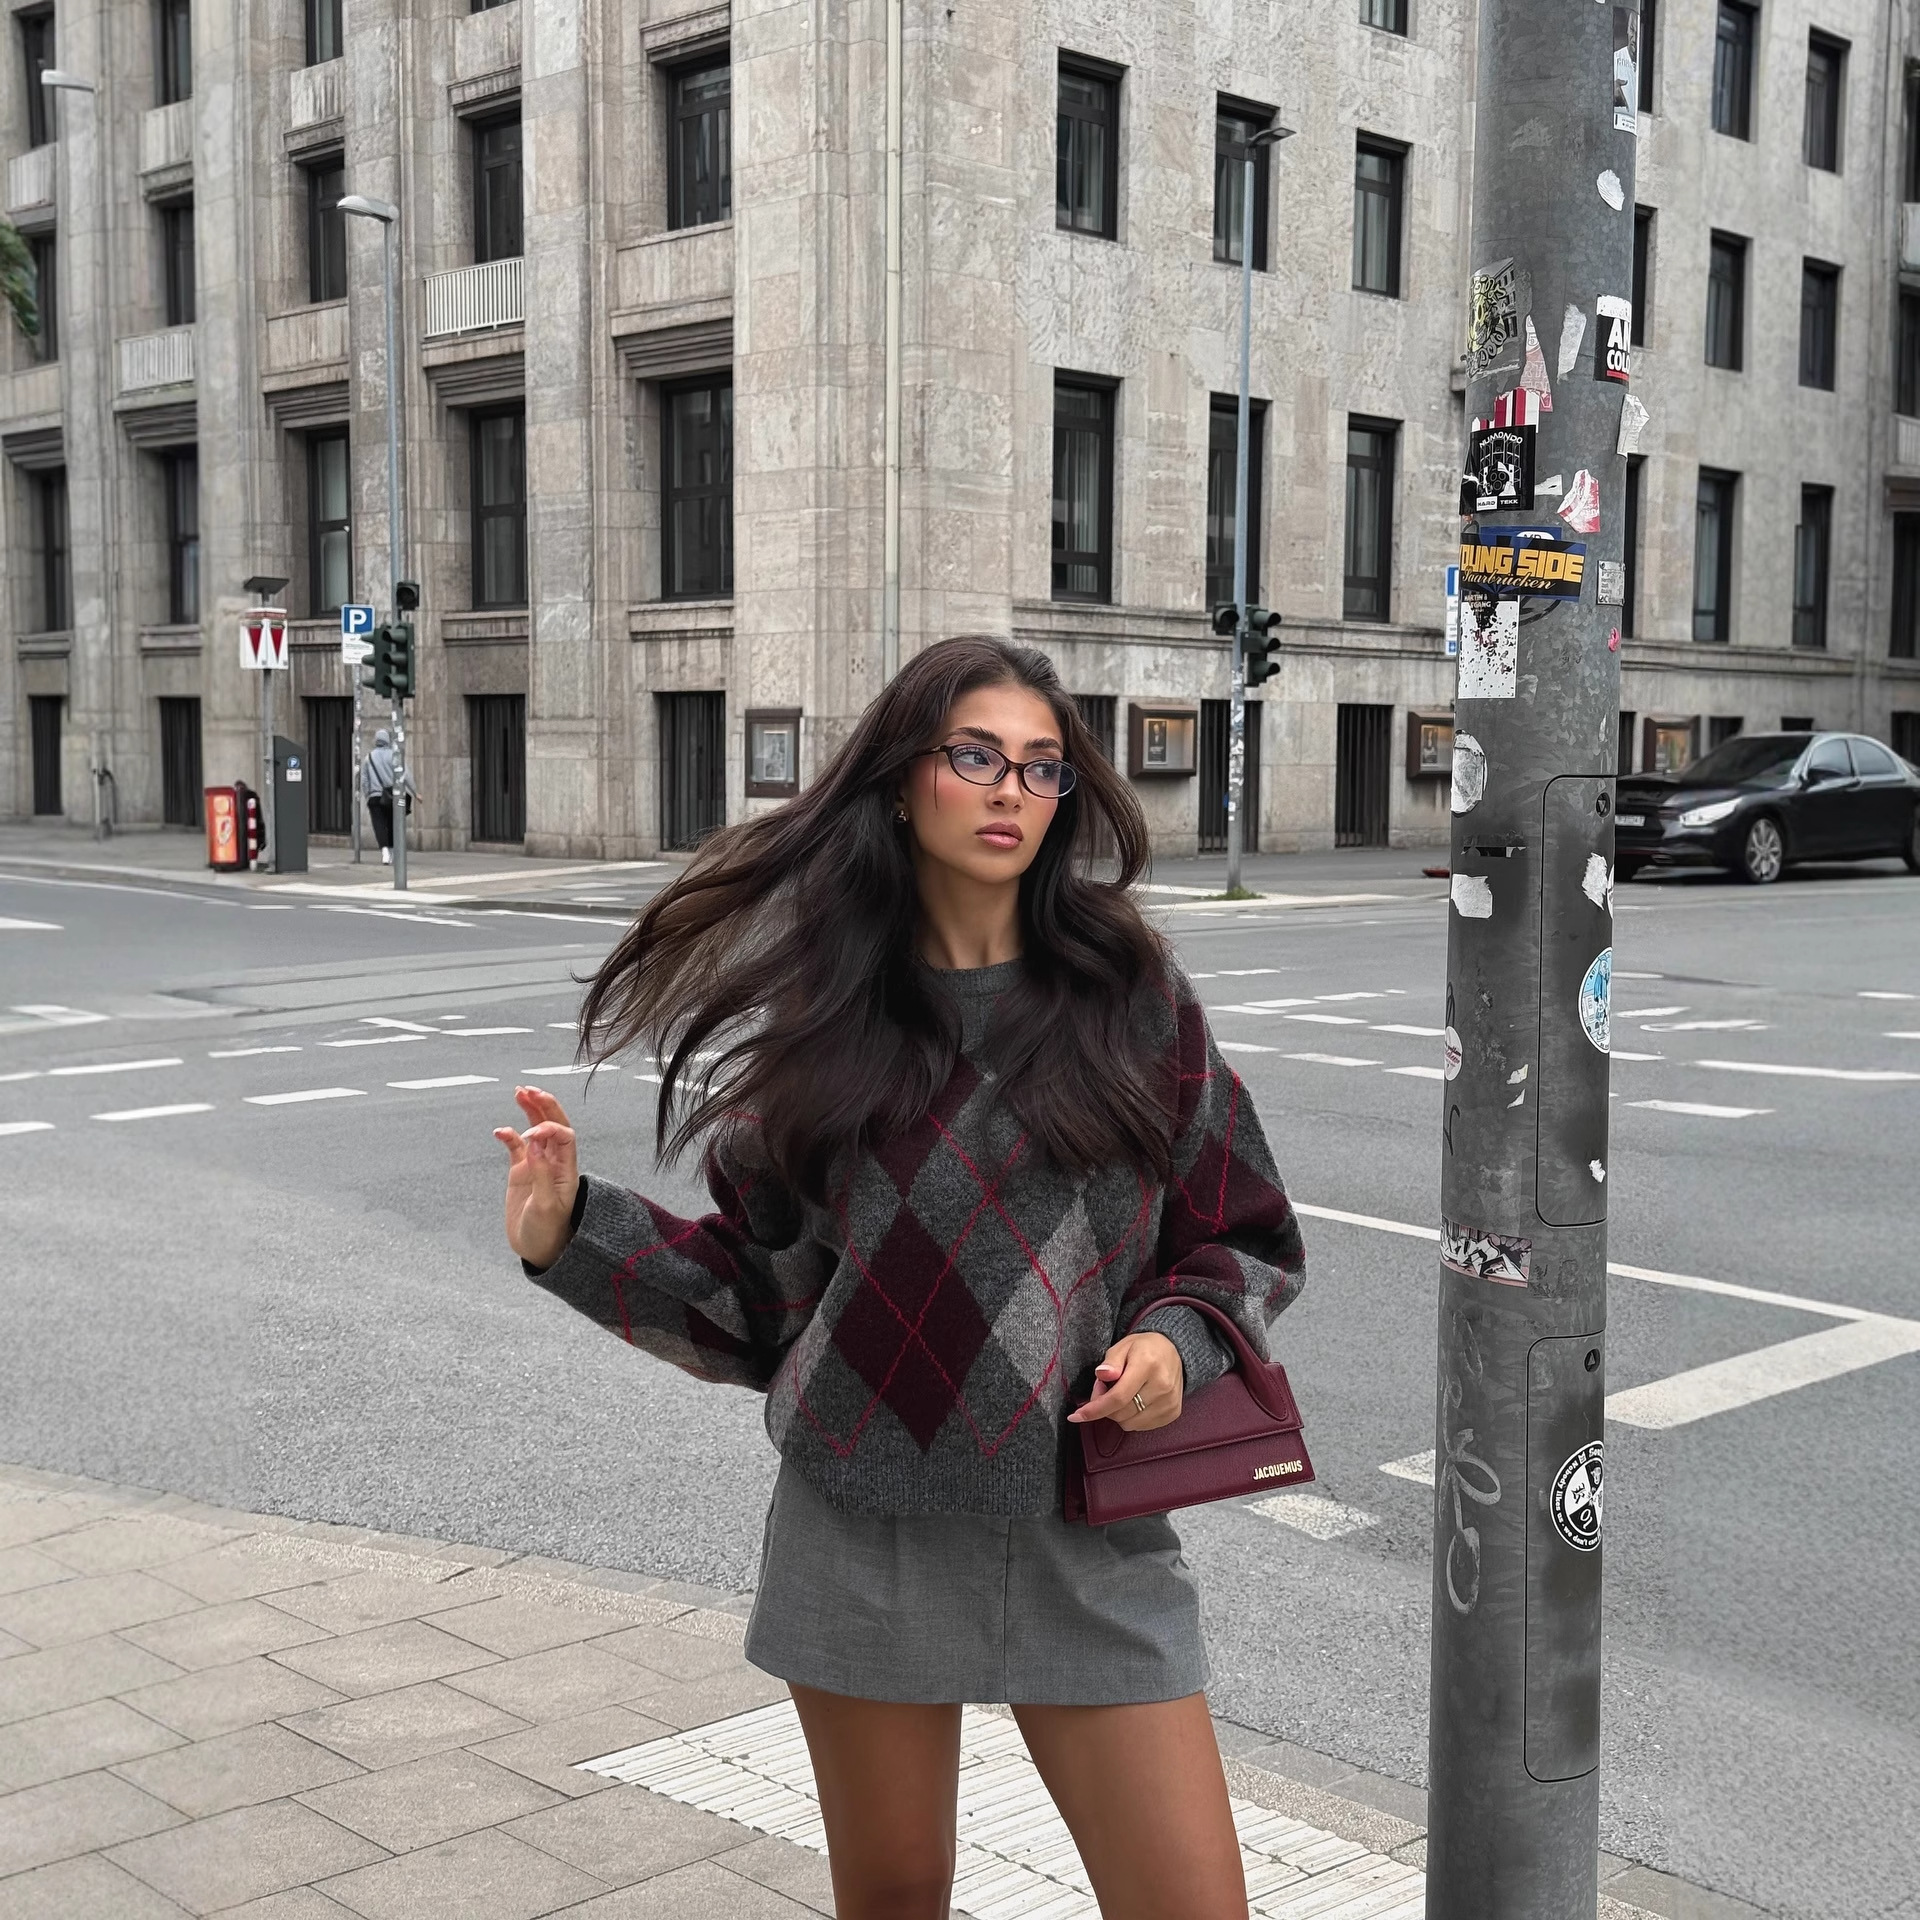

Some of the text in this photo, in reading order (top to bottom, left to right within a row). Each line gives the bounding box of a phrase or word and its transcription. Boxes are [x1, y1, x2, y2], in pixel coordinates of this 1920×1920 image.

[1479, 431, 1523, 449] NUMONDO
[1516, 548, 1584, 583] SIDE
[1462, 569, 1555, 590] Saarbrücken
[349, 609, 367, 633] P
[1253, 1460, 1303, 1480] JACQUEMUS
[1557, 1460, 1579, 1490] Nobody
[1555, 1490, 1563, 1511] likes
